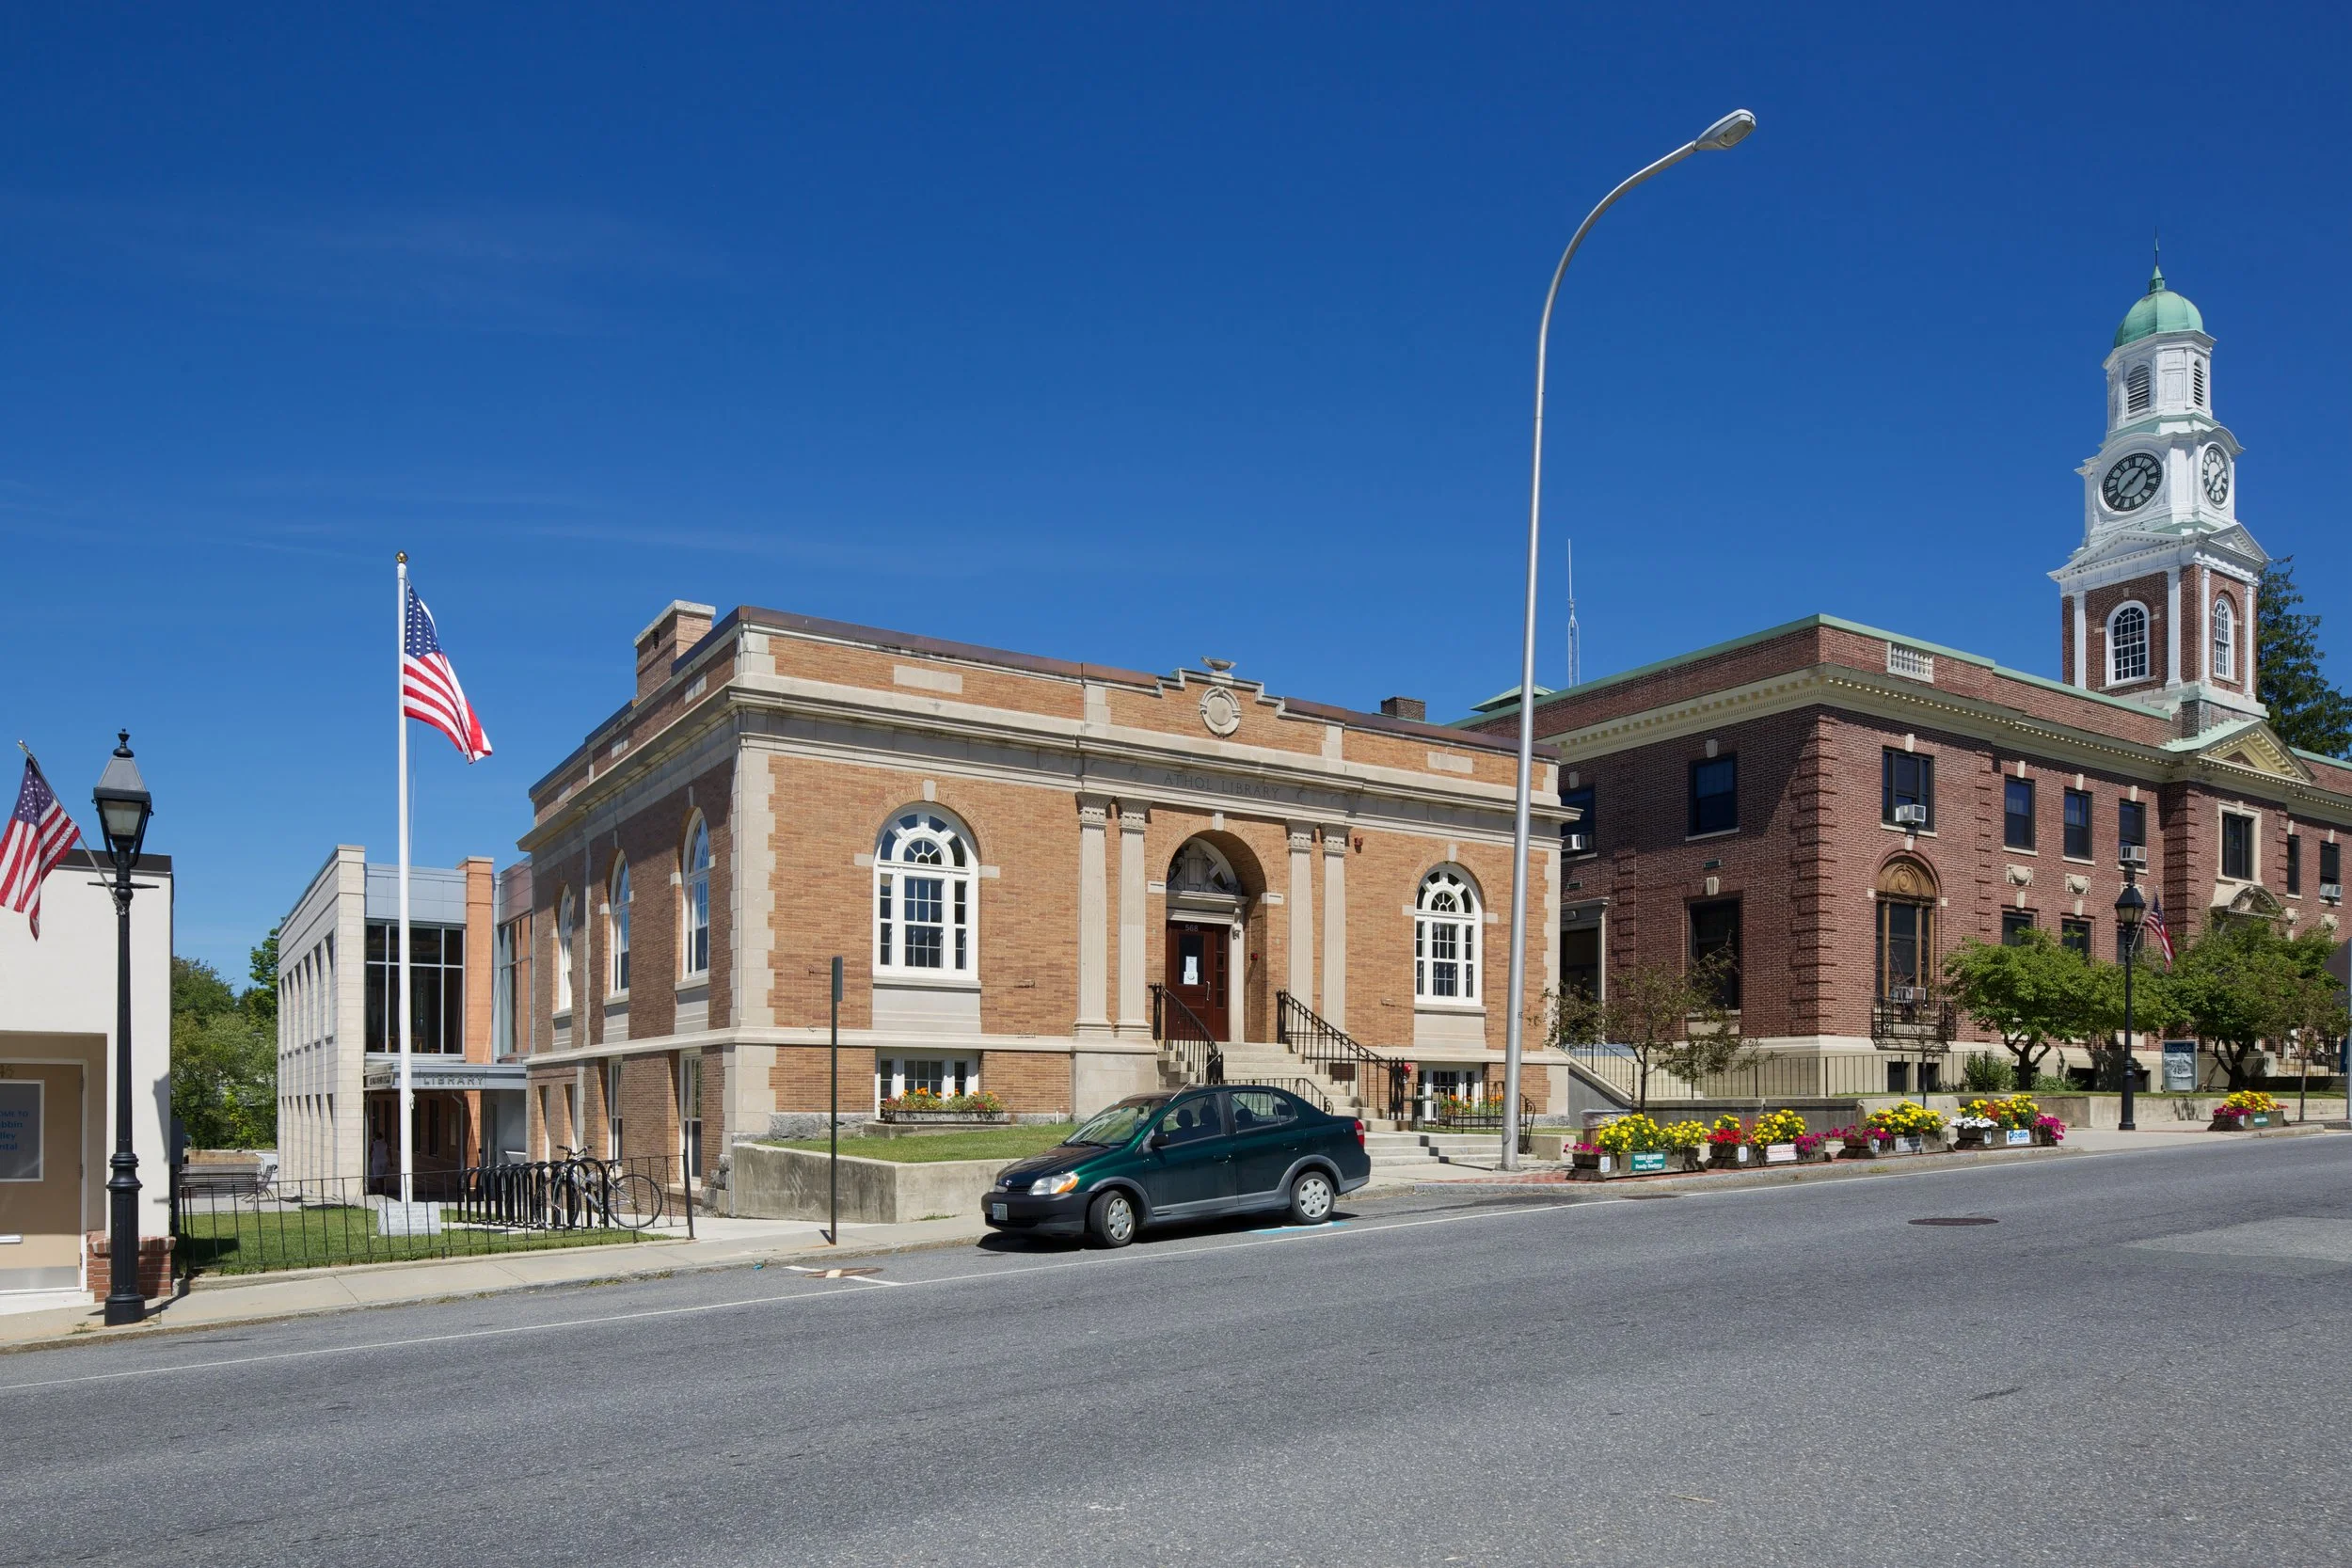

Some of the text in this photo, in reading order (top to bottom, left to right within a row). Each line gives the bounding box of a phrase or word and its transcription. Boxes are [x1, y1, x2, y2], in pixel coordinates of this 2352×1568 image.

[1164, 772, 1279, 799] ATHOL LIBRARY
[1185, 924, 1199, 932] 568
[423, 1074, 484, 1085] LIBRARY
